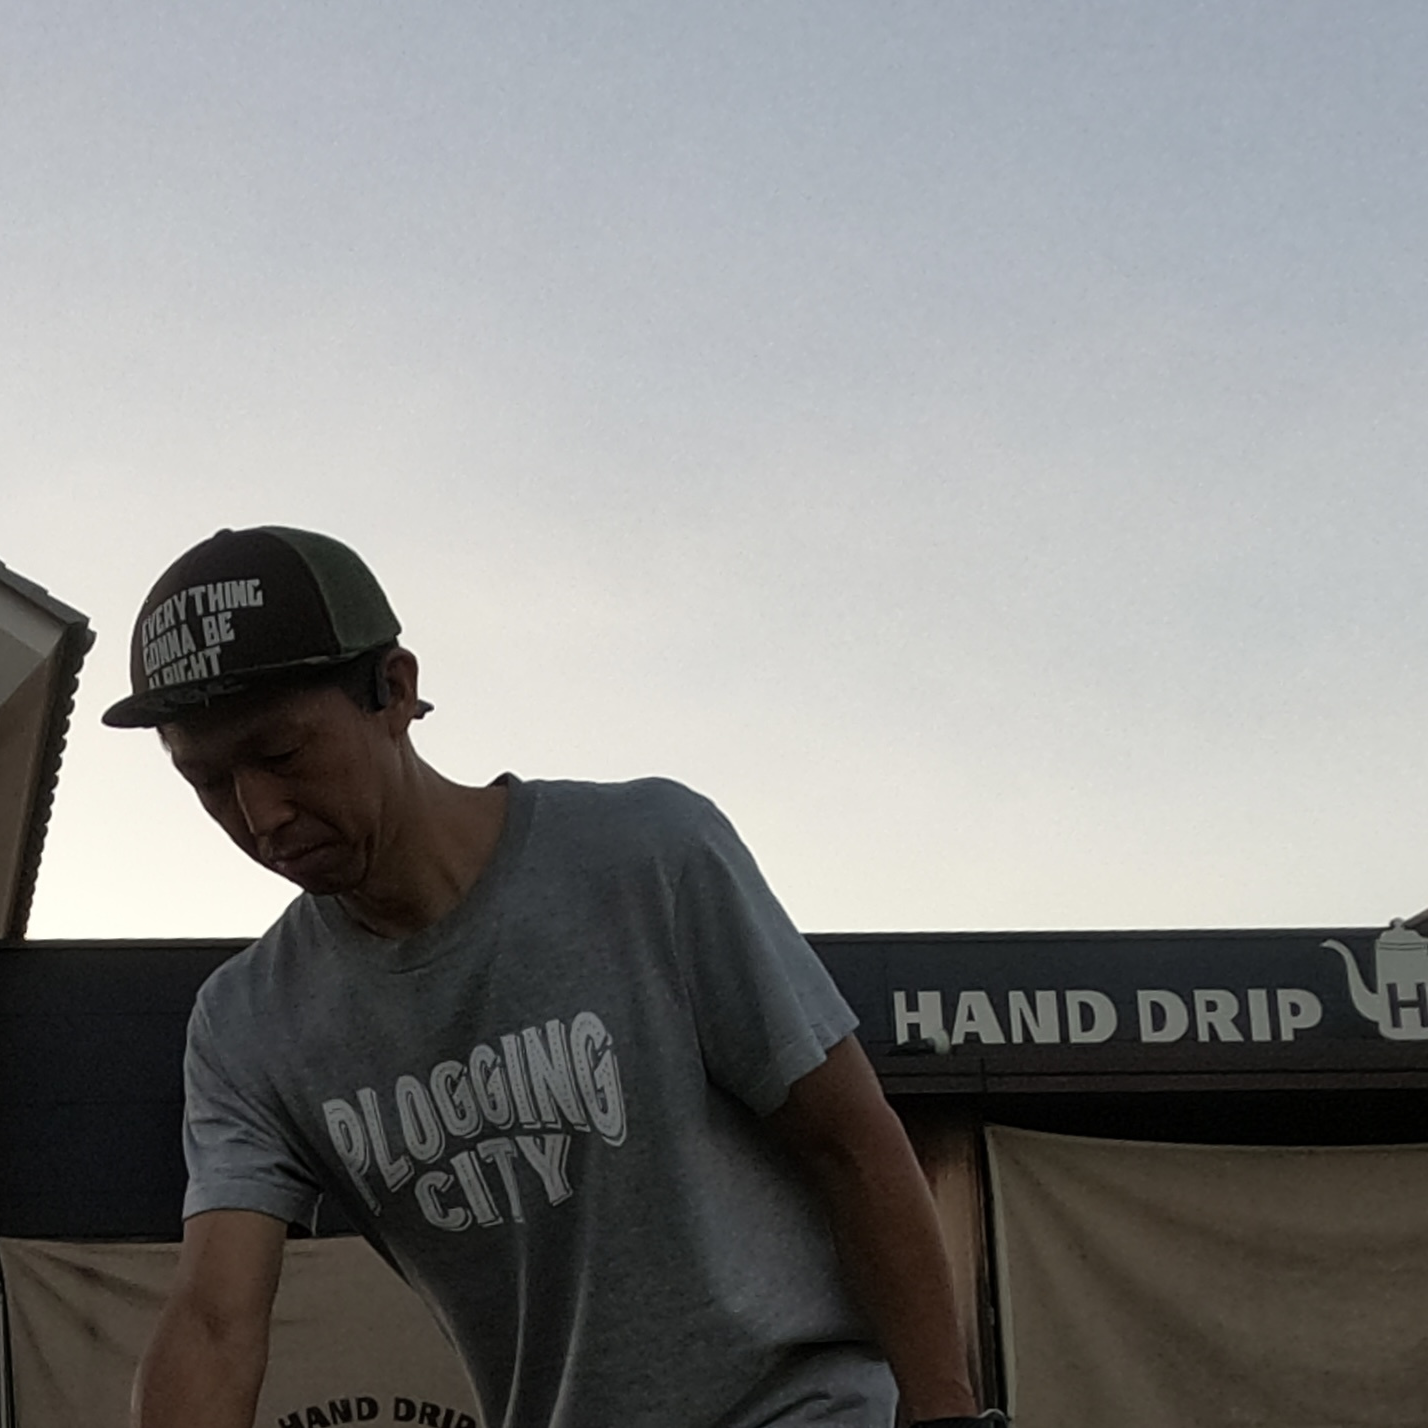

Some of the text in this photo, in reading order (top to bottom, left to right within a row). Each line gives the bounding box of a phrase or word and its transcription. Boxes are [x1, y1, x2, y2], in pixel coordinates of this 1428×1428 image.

[142, 579, 264, 645] EVERYTHING
[142, 611, 236, 675] GONNA BE
[892, 987, 1324, 1045] HAND DRIP
[1386, 982, 1428, 1028] H
[322, 1011, 627, 1217] PLOGGING
[413, 1133, 574, 1232] CITY
